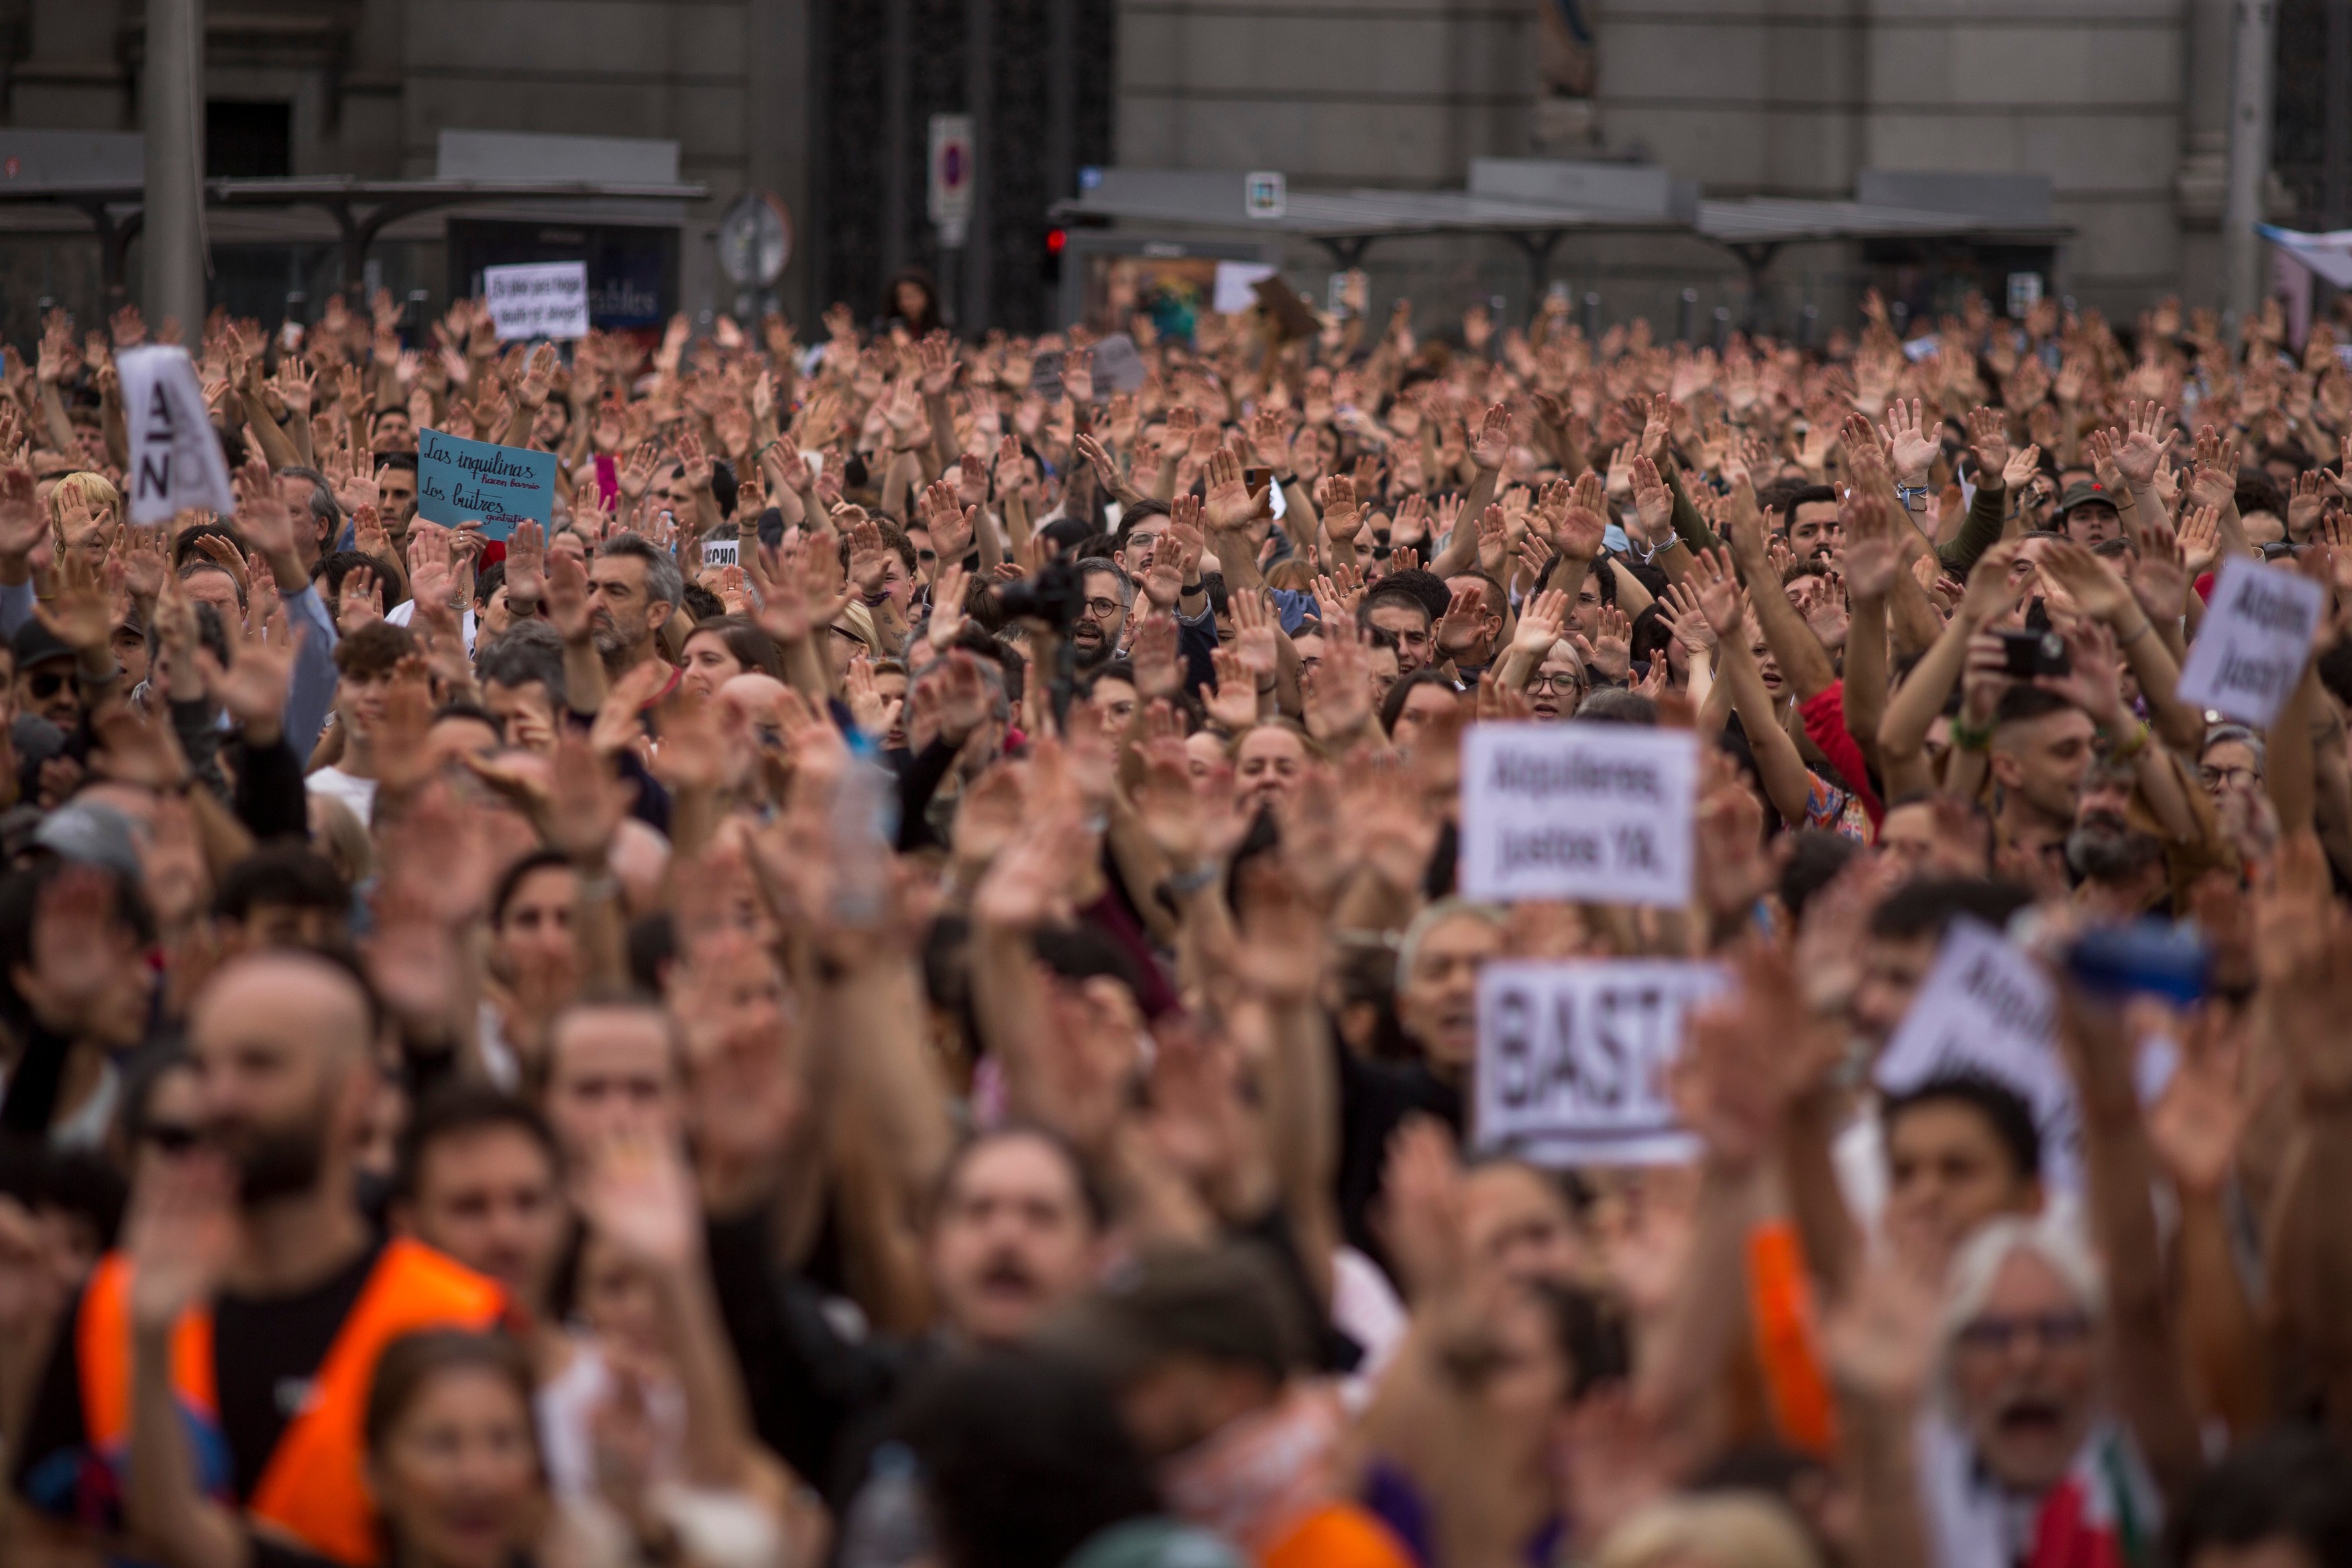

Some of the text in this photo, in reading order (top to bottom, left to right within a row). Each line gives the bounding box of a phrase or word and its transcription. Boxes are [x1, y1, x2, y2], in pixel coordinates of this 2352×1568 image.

[424, 437, 537, 480] Las inquilinas
[422, 476, 506, 514] Los buitres
[481, 473, 542, 490] hacen barrio
[484, 512, 539, 529] gentrificn
[1496, 987, 1680, 1110] BAST
